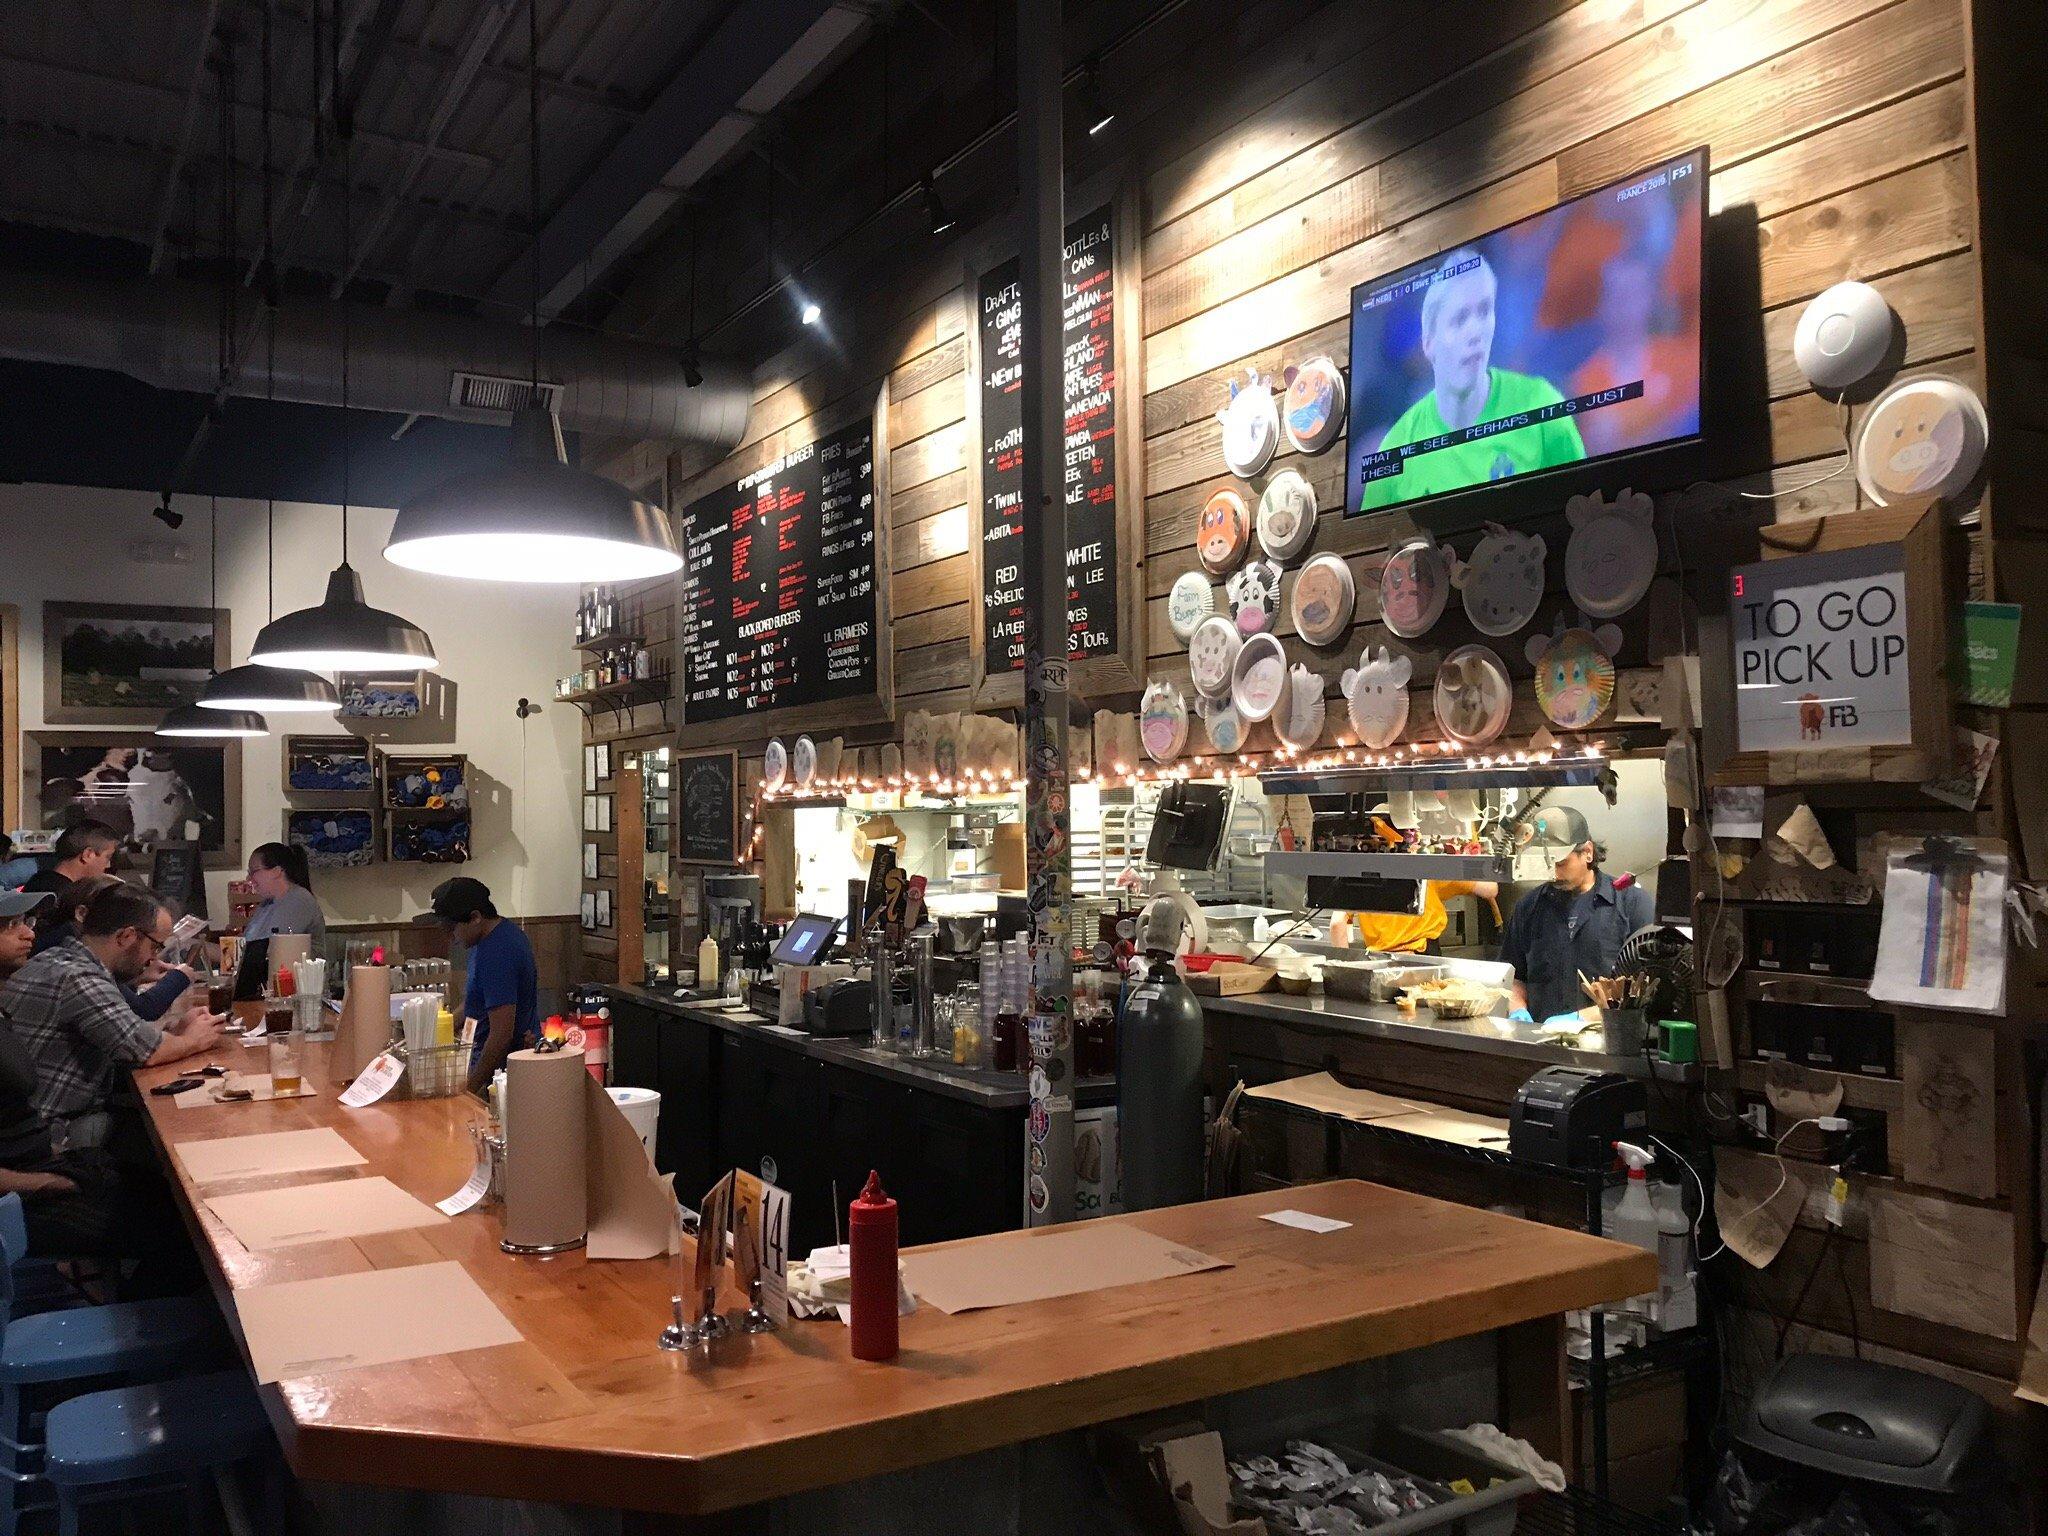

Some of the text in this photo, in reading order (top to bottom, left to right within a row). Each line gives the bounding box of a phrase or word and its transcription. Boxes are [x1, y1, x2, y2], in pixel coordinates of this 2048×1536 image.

[1617, 184, 1647, 202] FRANCE
[1672, 163, 1693, 180] FS1
[1100, 223, 1110, 241] &
[991, 367, 1014, 388] NEW
[1362, 449, 1391, 468] WHAT
[1400, 442, 1416, 457] WE
[1465, 413, 1529, 440] PERHAPS
[1540, 400, 1578, 420] IT'S
[1585, 386, 1627, 409] JUST
[1362, 463, 1400, 483] THESE
[993, 493, 1017, 510] TWIN
[988, 523, 1012, 541] ABITA
[1066, 542, 1102, 567] WHITE
[996, 565, 1018, 585] RED
[1086, 567, 1104, 585] LEE
[774, 609, 801, 628] BURGERS
[1743, 586, 1896, 640] TO GO
[992, 621, 1005, 639] LA
[1081, 631, 1109, 648] TOURS
[1742, 634, 1905, 685] PICK UP
[761, 1190, 785, 1278] 14
